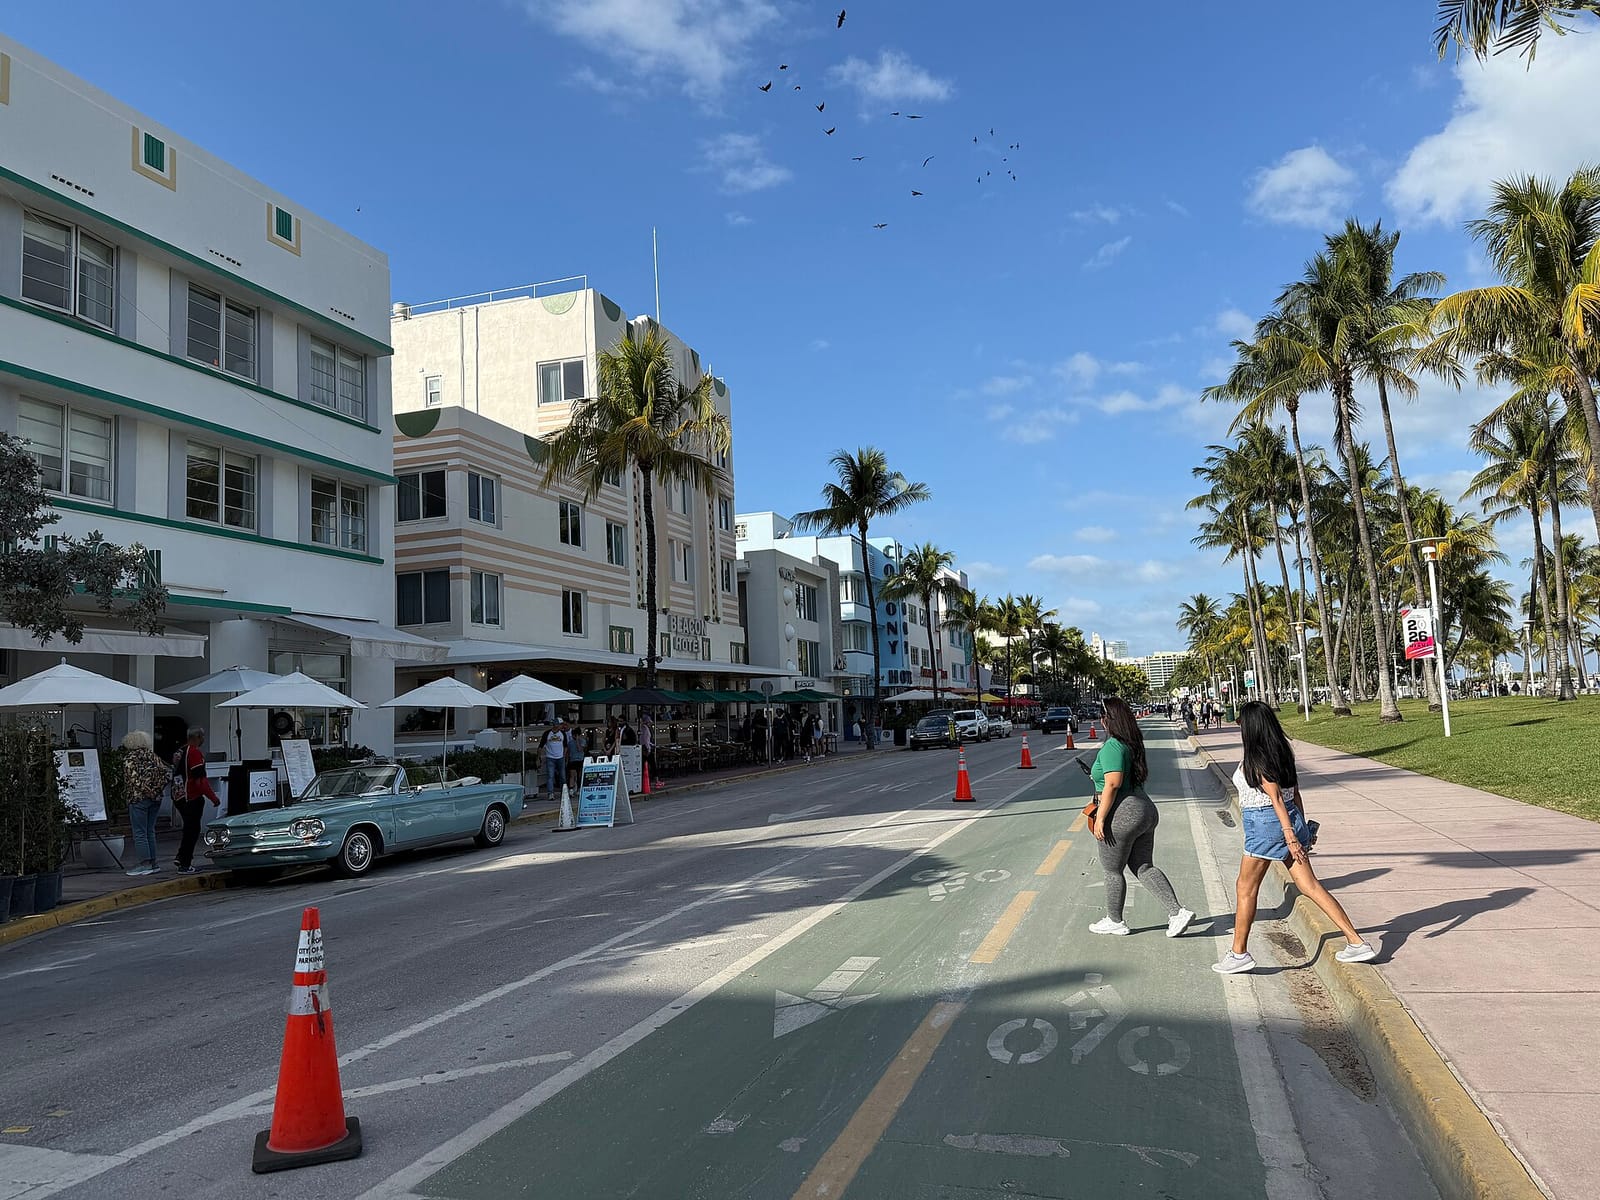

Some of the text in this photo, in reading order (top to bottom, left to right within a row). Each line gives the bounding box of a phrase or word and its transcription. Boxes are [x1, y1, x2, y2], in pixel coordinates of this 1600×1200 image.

[883, 544, 898, 655] COONY
[671, 614, 706, 637] BEACON
[676, 636, 700, 653] HOTE
